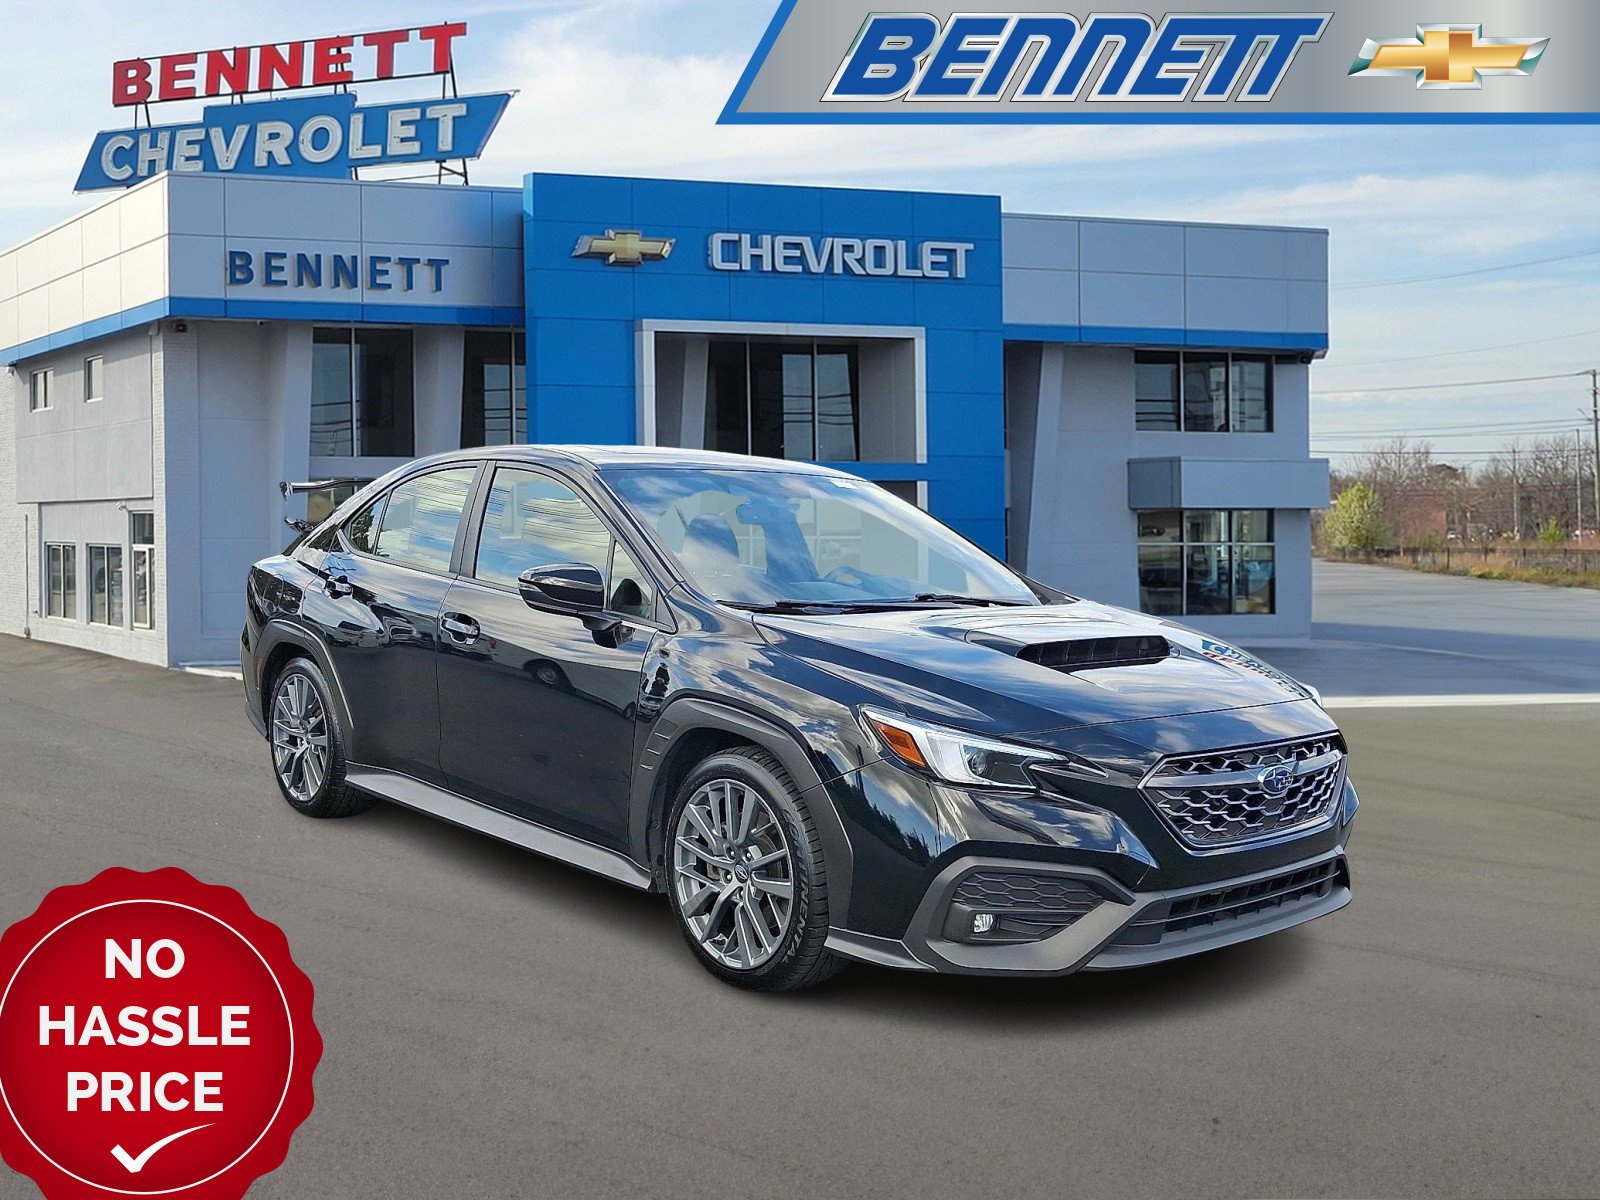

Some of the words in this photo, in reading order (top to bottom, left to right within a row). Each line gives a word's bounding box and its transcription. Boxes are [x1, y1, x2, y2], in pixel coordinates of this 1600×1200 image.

[113, 22, 467, 105] BENNETT
[100, 103, 467, 180] CHEVROLET
[226, 249, 450, 292] BENNETT
[707, 231, 975, 279] CHEVROLET
